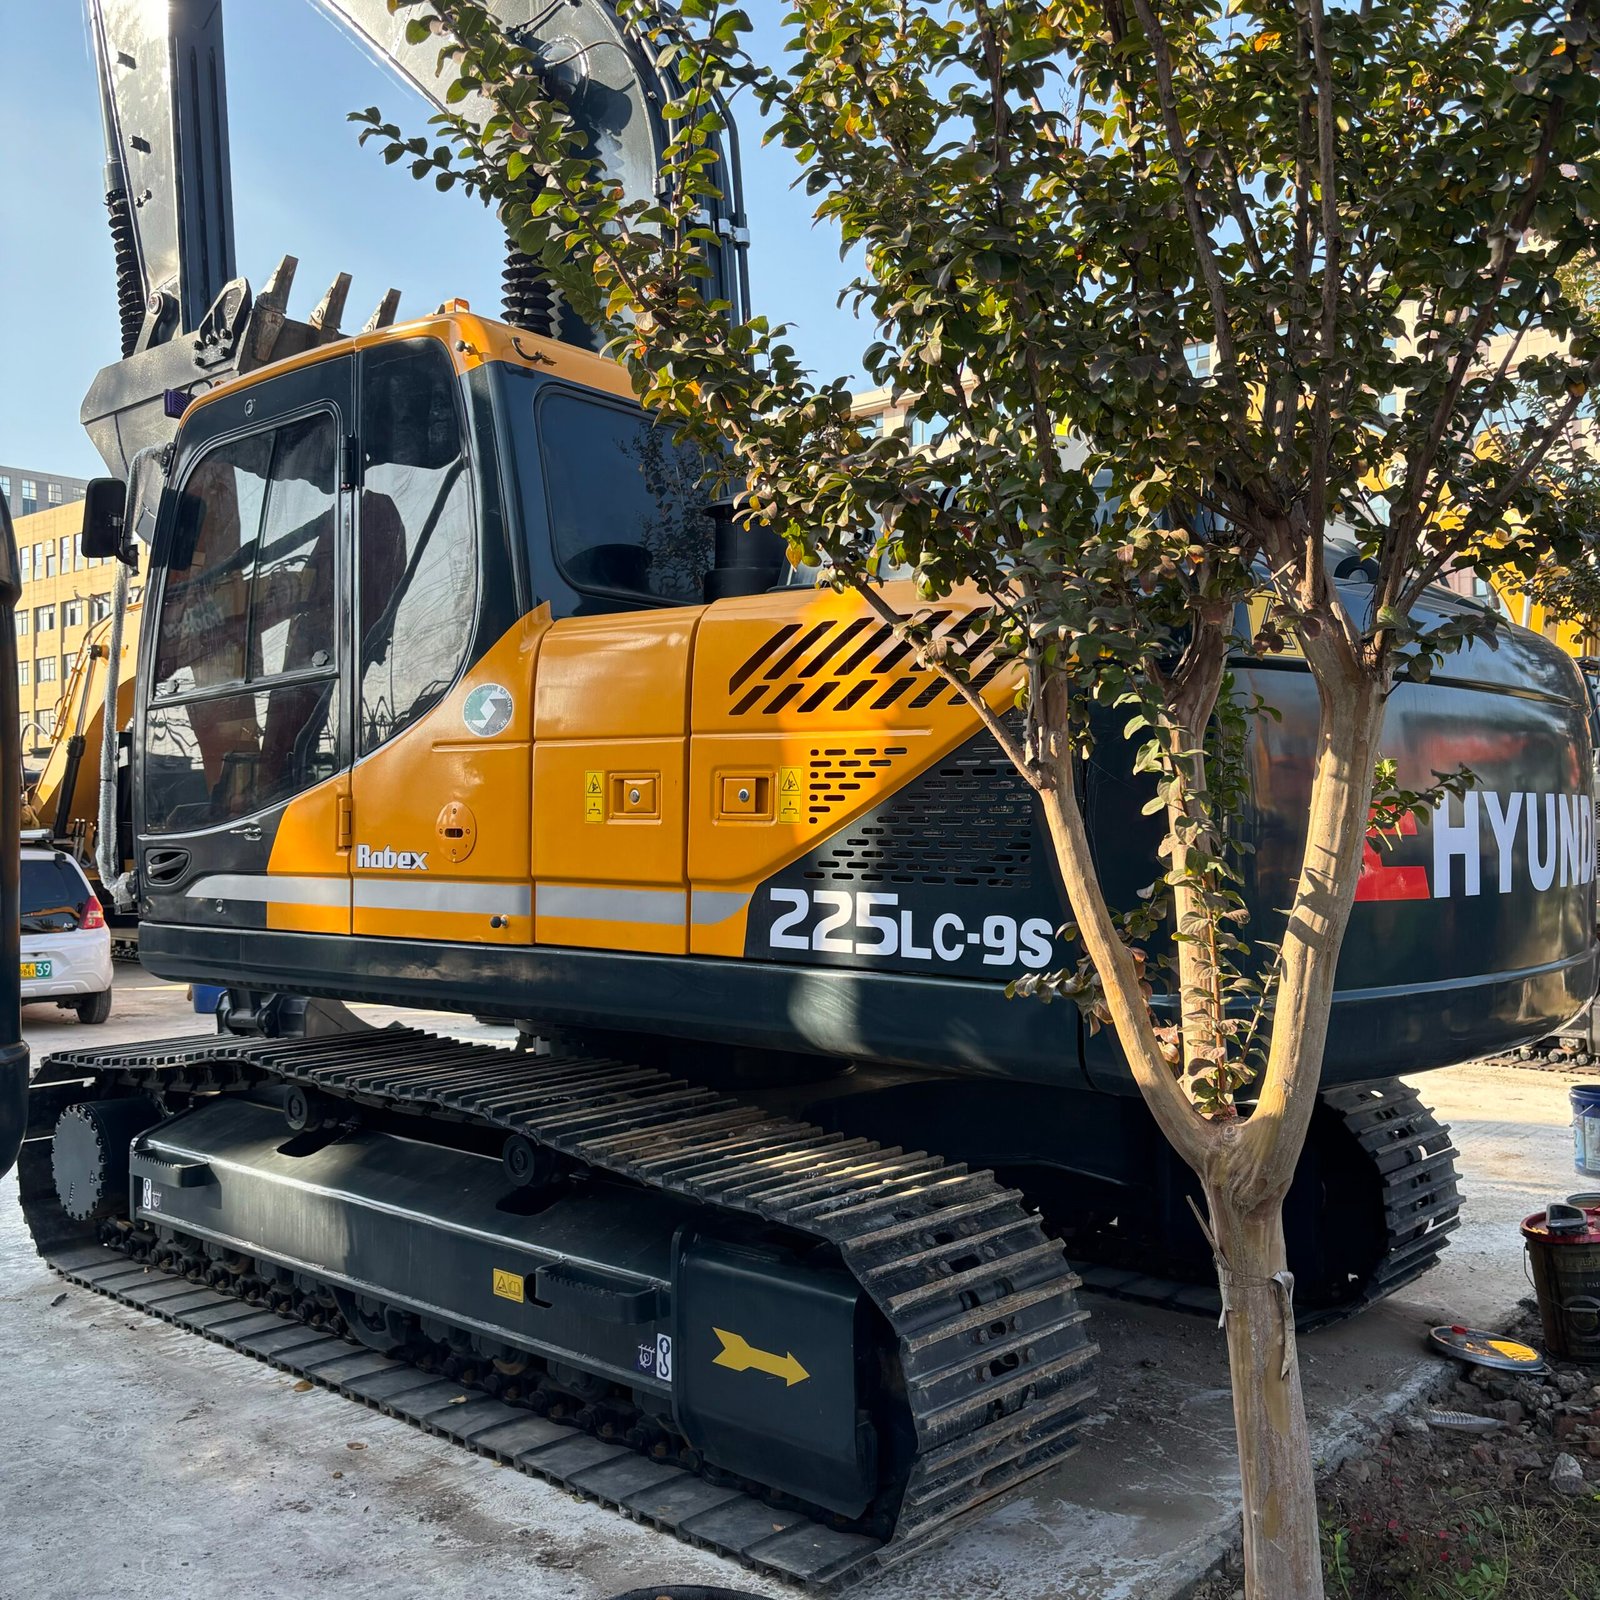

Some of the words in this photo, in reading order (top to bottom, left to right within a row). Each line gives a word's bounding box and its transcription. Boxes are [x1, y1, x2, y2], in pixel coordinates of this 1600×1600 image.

[356, 843, 429, 871] Robex
[1433, 790, 1596, 899] HYUND
[769, 887, 1054, 969] 225LC-9S
